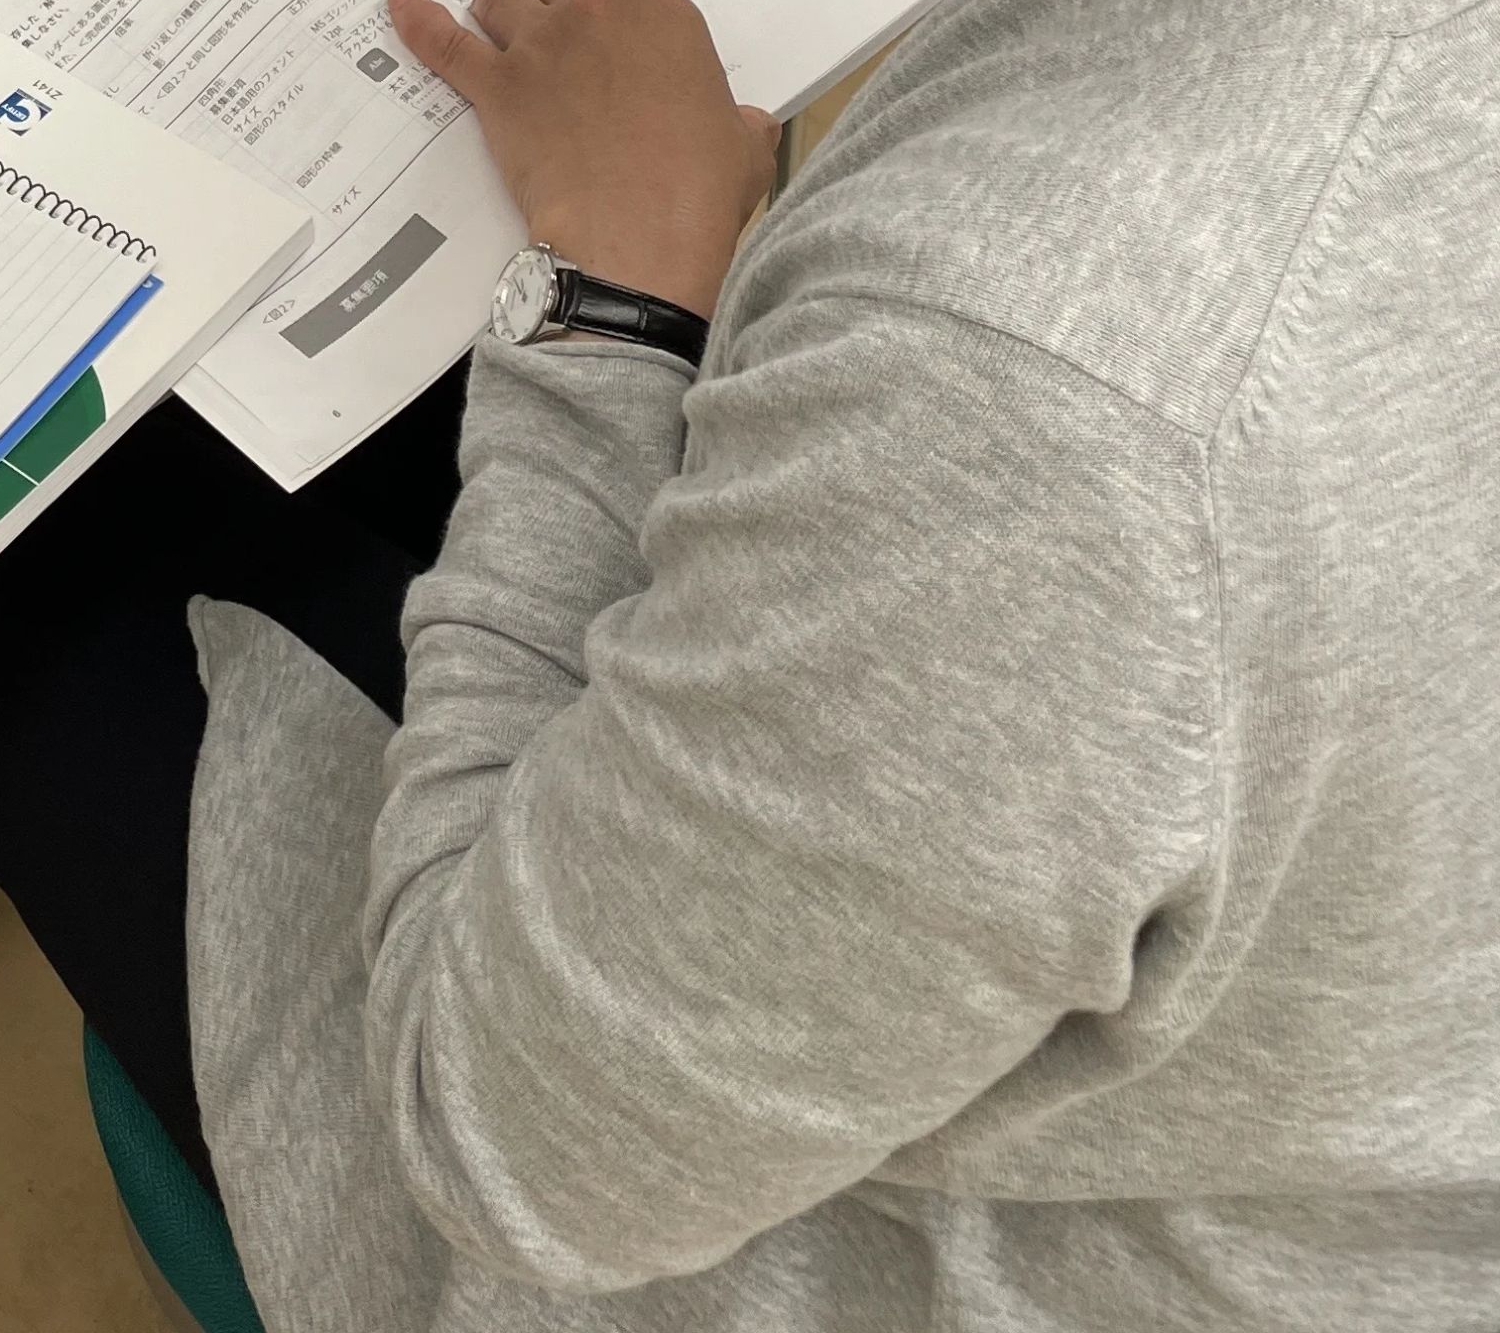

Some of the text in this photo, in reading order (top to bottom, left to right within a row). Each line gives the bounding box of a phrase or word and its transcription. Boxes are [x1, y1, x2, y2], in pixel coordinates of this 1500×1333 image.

[113, 18, 136, 39] 倍率
[309, 12, 330, 36] MS
[321, 23, 343, 42] 12pt
[32, 77, 65, 102] Z141
[197, 77, 228, 107] 四角形
[209, 76, 248, 117] 募集要項
[220, 48, 297, 126] 日本語用のフォント
[232, 107, 263, 135] サイズ
[243, 81, 305, 146] 図形のスタイル
[296, 140, 344, 189] 図形の枠線
[330, 185, 362, 216] サイズ
[338, 269, 390, 314] 募集要項
